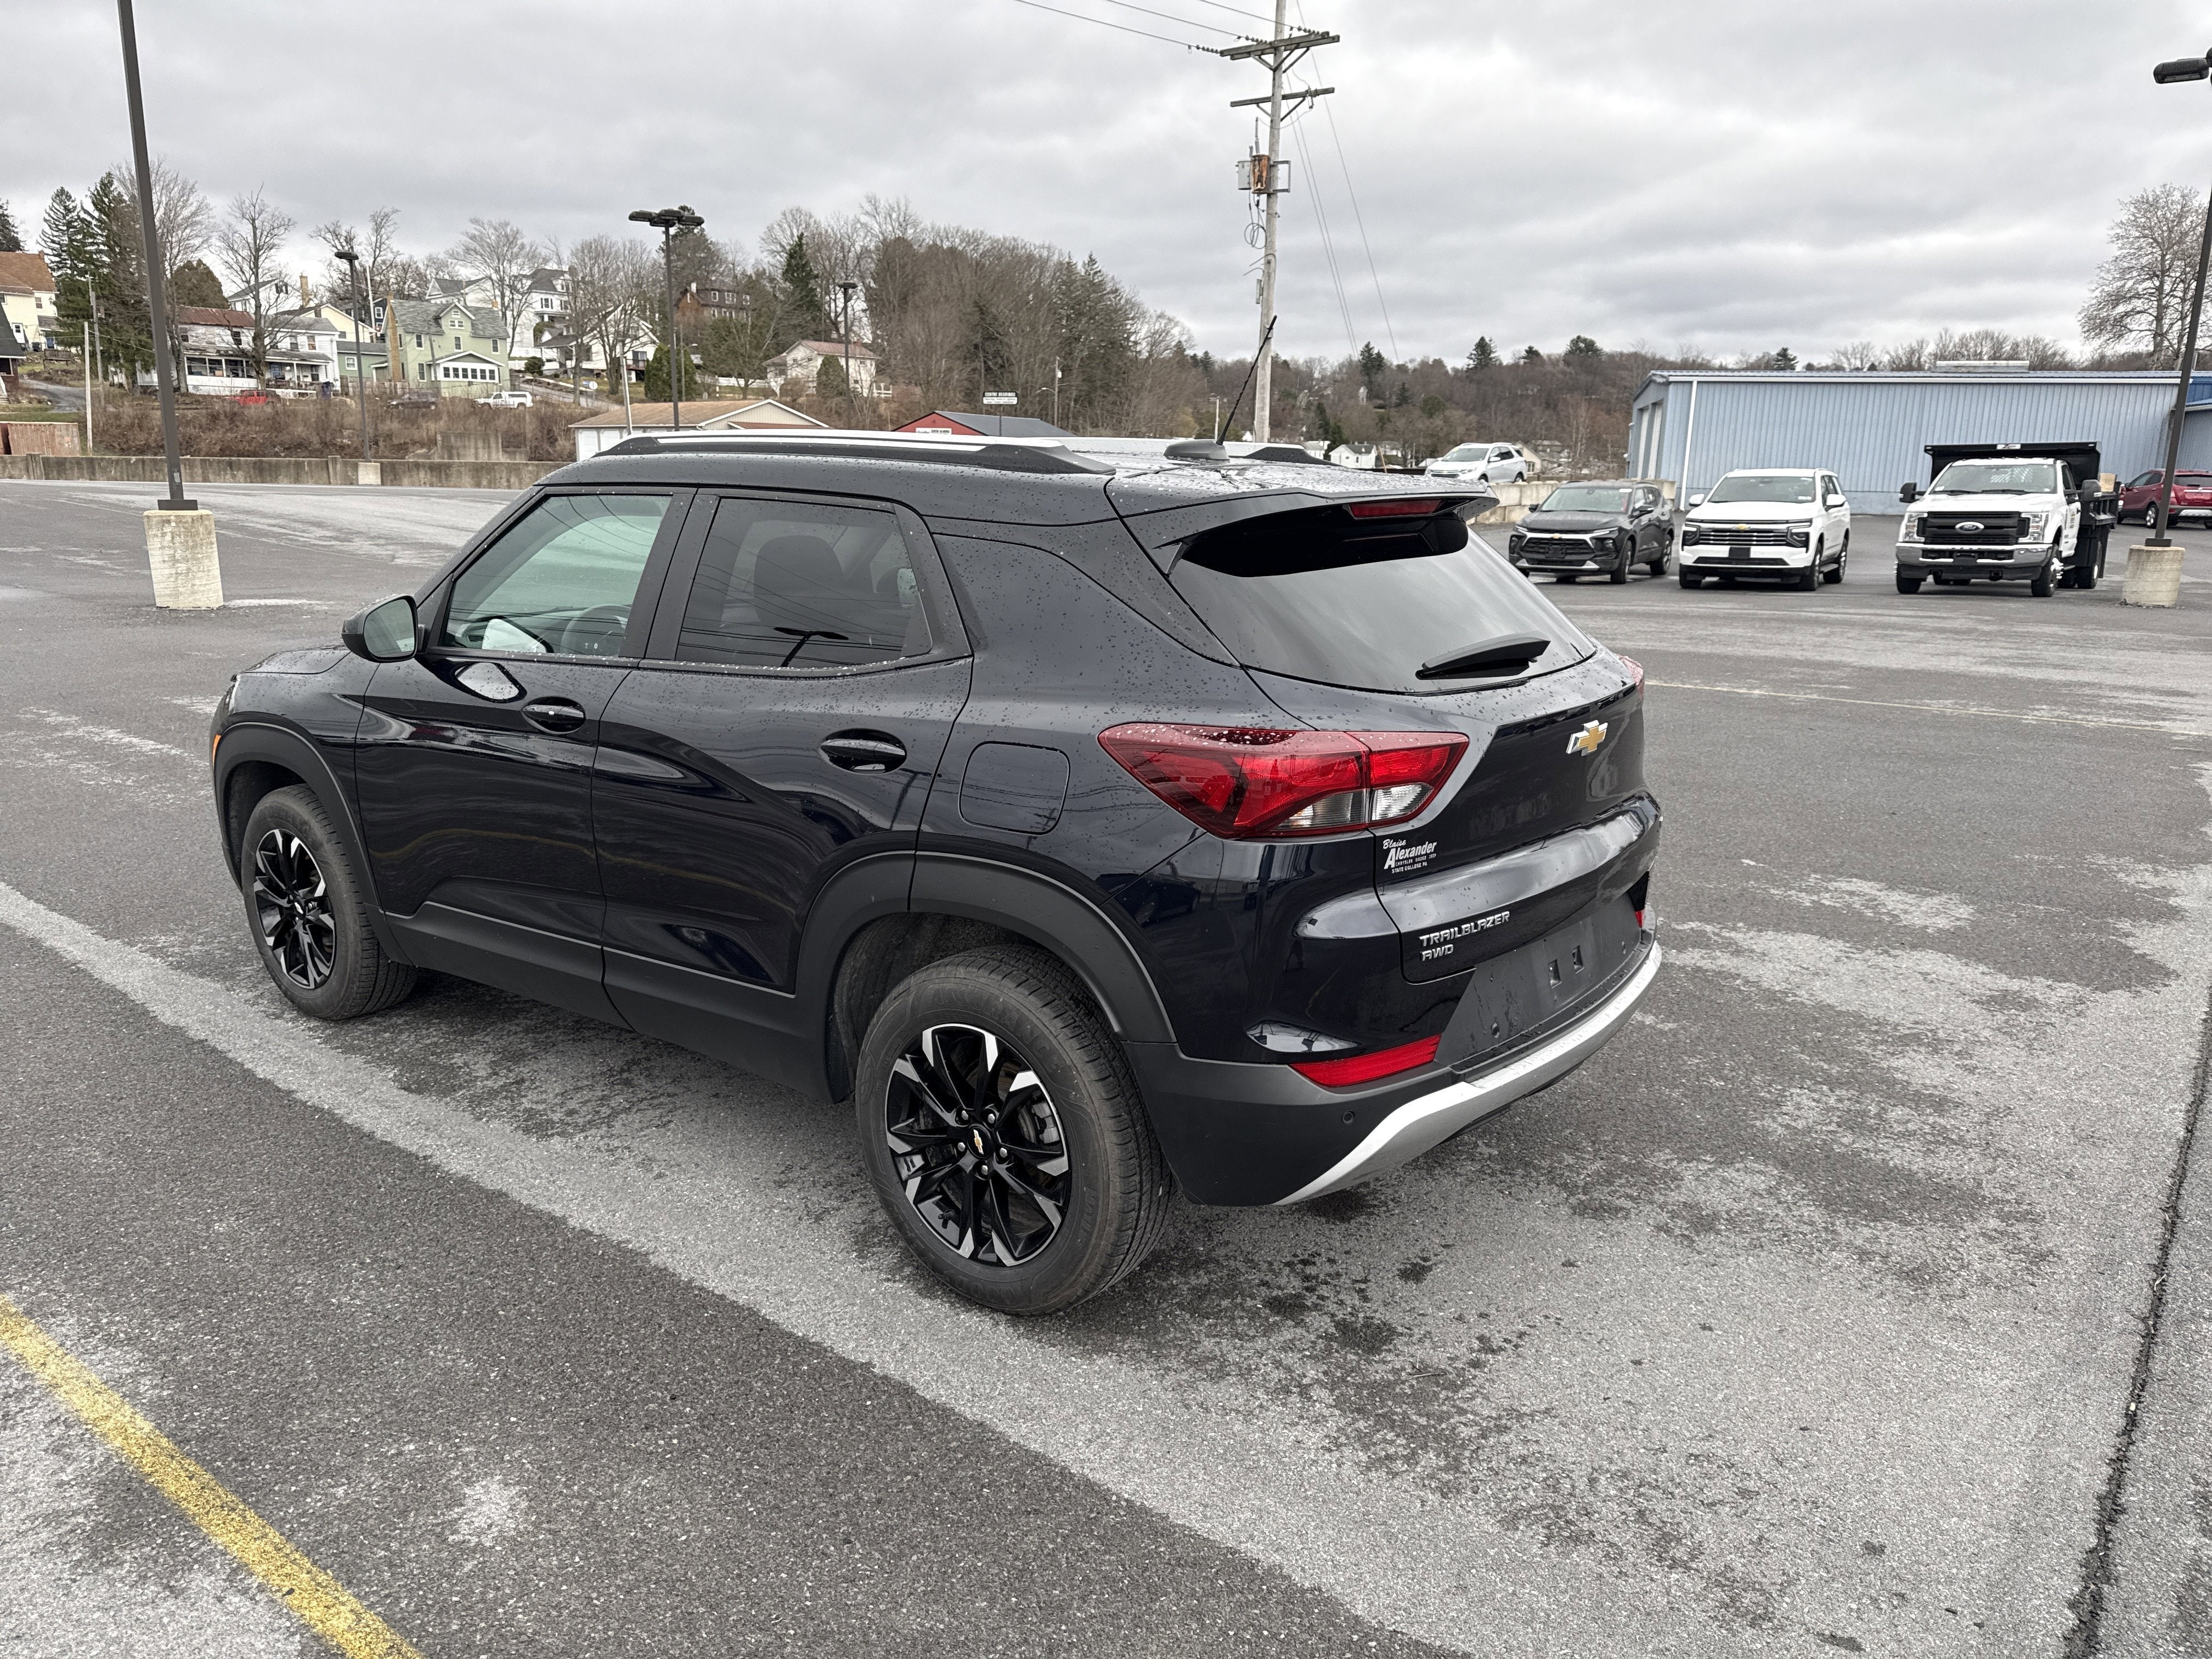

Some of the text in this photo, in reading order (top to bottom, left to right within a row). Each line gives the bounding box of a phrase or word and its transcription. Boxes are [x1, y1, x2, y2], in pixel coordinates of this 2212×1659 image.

[1383, 839, 1406, 849] Blaise
[1384, 841, 1437, 870] Alexander
[1404, 863, 1422, 871] COLLEGE
[1419, 911, 1510, 947] TRAILBLAZER
[1421, 944, 1454, 961] AWD
[931, 986, 1063, 1074] ASSURANCE
